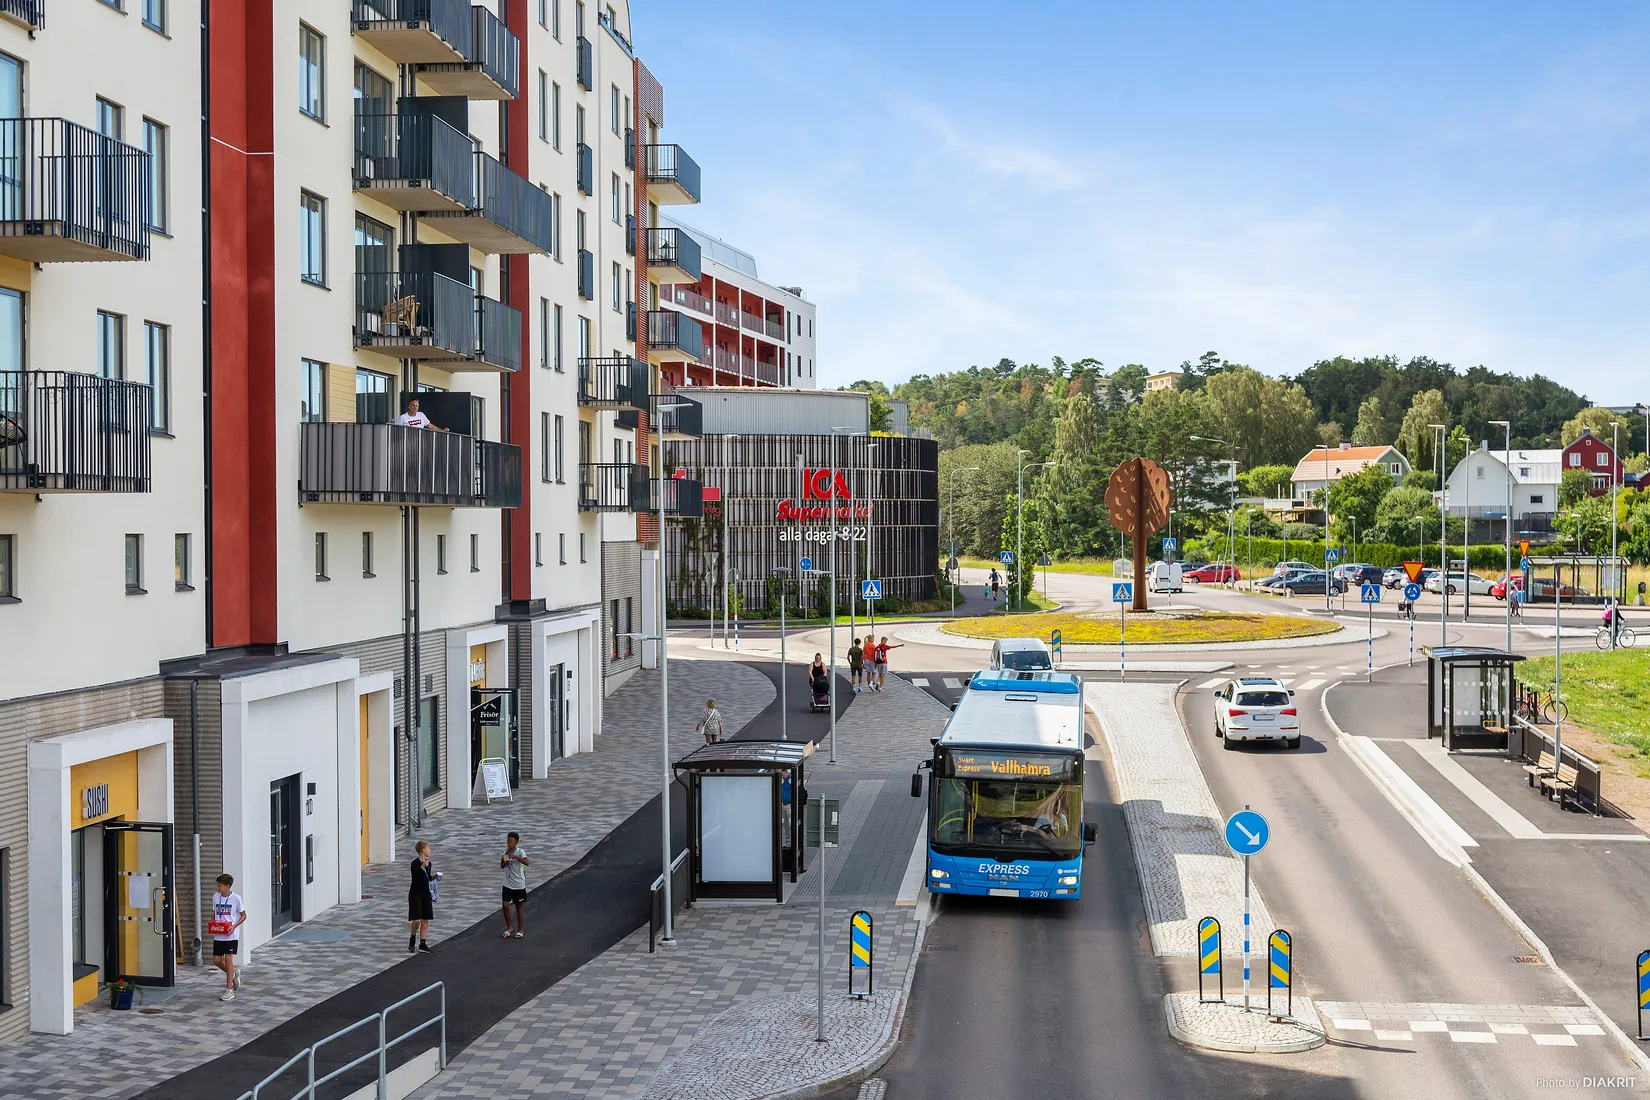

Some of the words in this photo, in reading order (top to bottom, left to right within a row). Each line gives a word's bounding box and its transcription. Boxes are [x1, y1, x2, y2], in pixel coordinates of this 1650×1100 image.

[803, 468, 852, 500] ICA
[780, 527, 801, 541] alla
[958, 756, 975, 764] Svart
[957, 764, 980, 773] Express
[991, 759, 1051, 776] Vallhamra
[86, 784, 109, 819] SUSHI
[978, 863, 1030, 875] EXPRESS
[988, 873, 1019, 882] MAN
[1030, 890, 1048, 898] 2970
